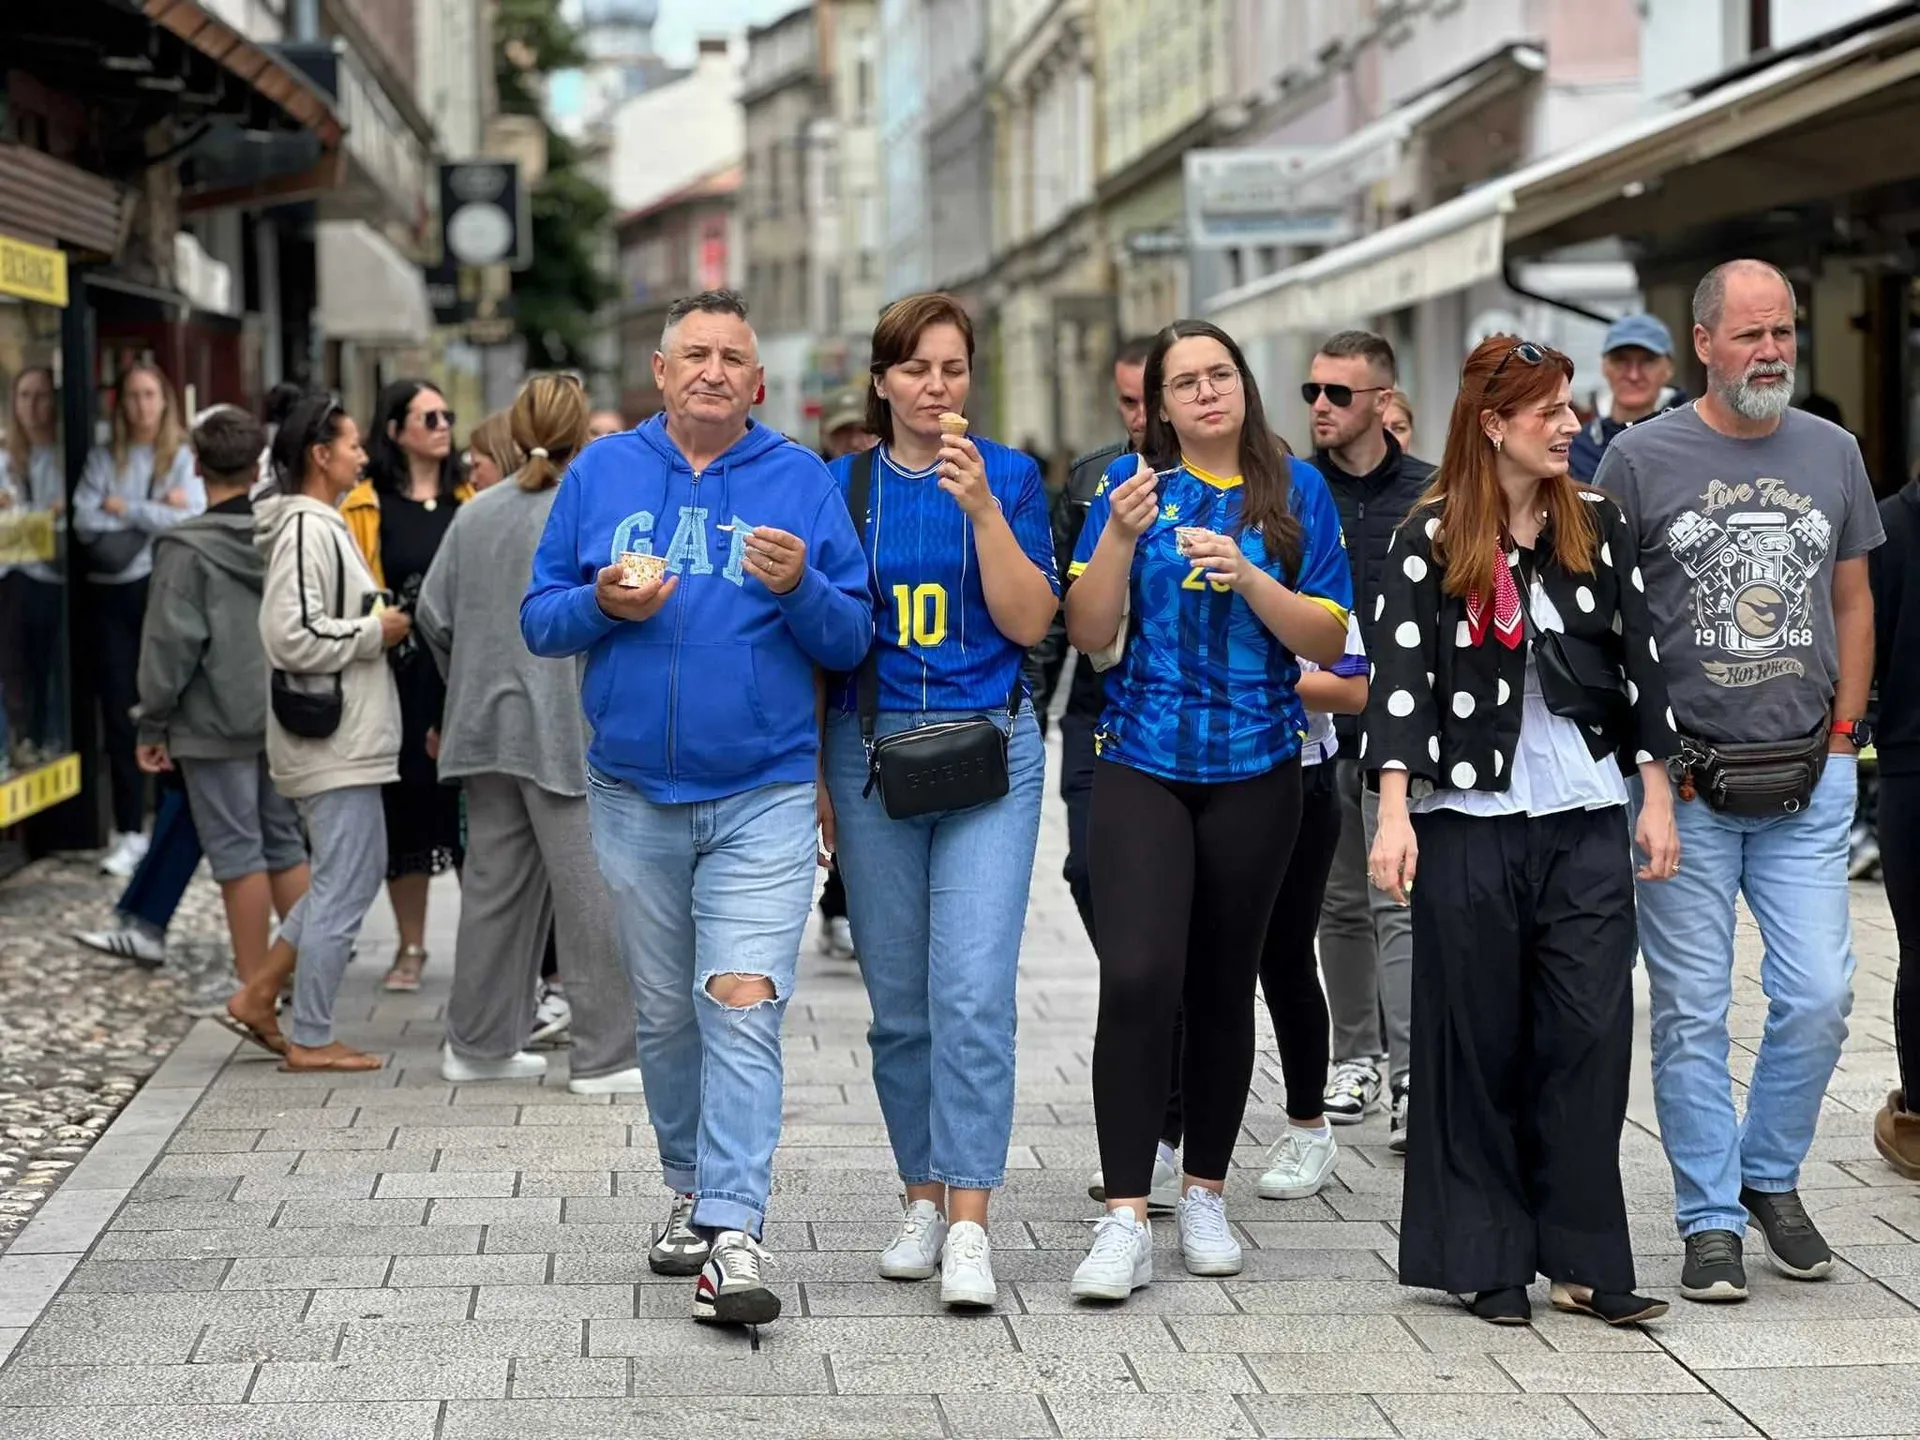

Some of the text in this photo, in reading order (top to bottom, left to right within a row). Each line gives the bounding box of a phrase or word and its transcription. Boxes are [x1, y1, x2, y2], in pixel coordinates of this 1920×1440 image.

[1699, 478, 1812, 516] Live Fast
[1181, 566, 1232, 593] 2
[892, 583, 948, 648] 10
[1695, 628, 1813, 646] 19 68
